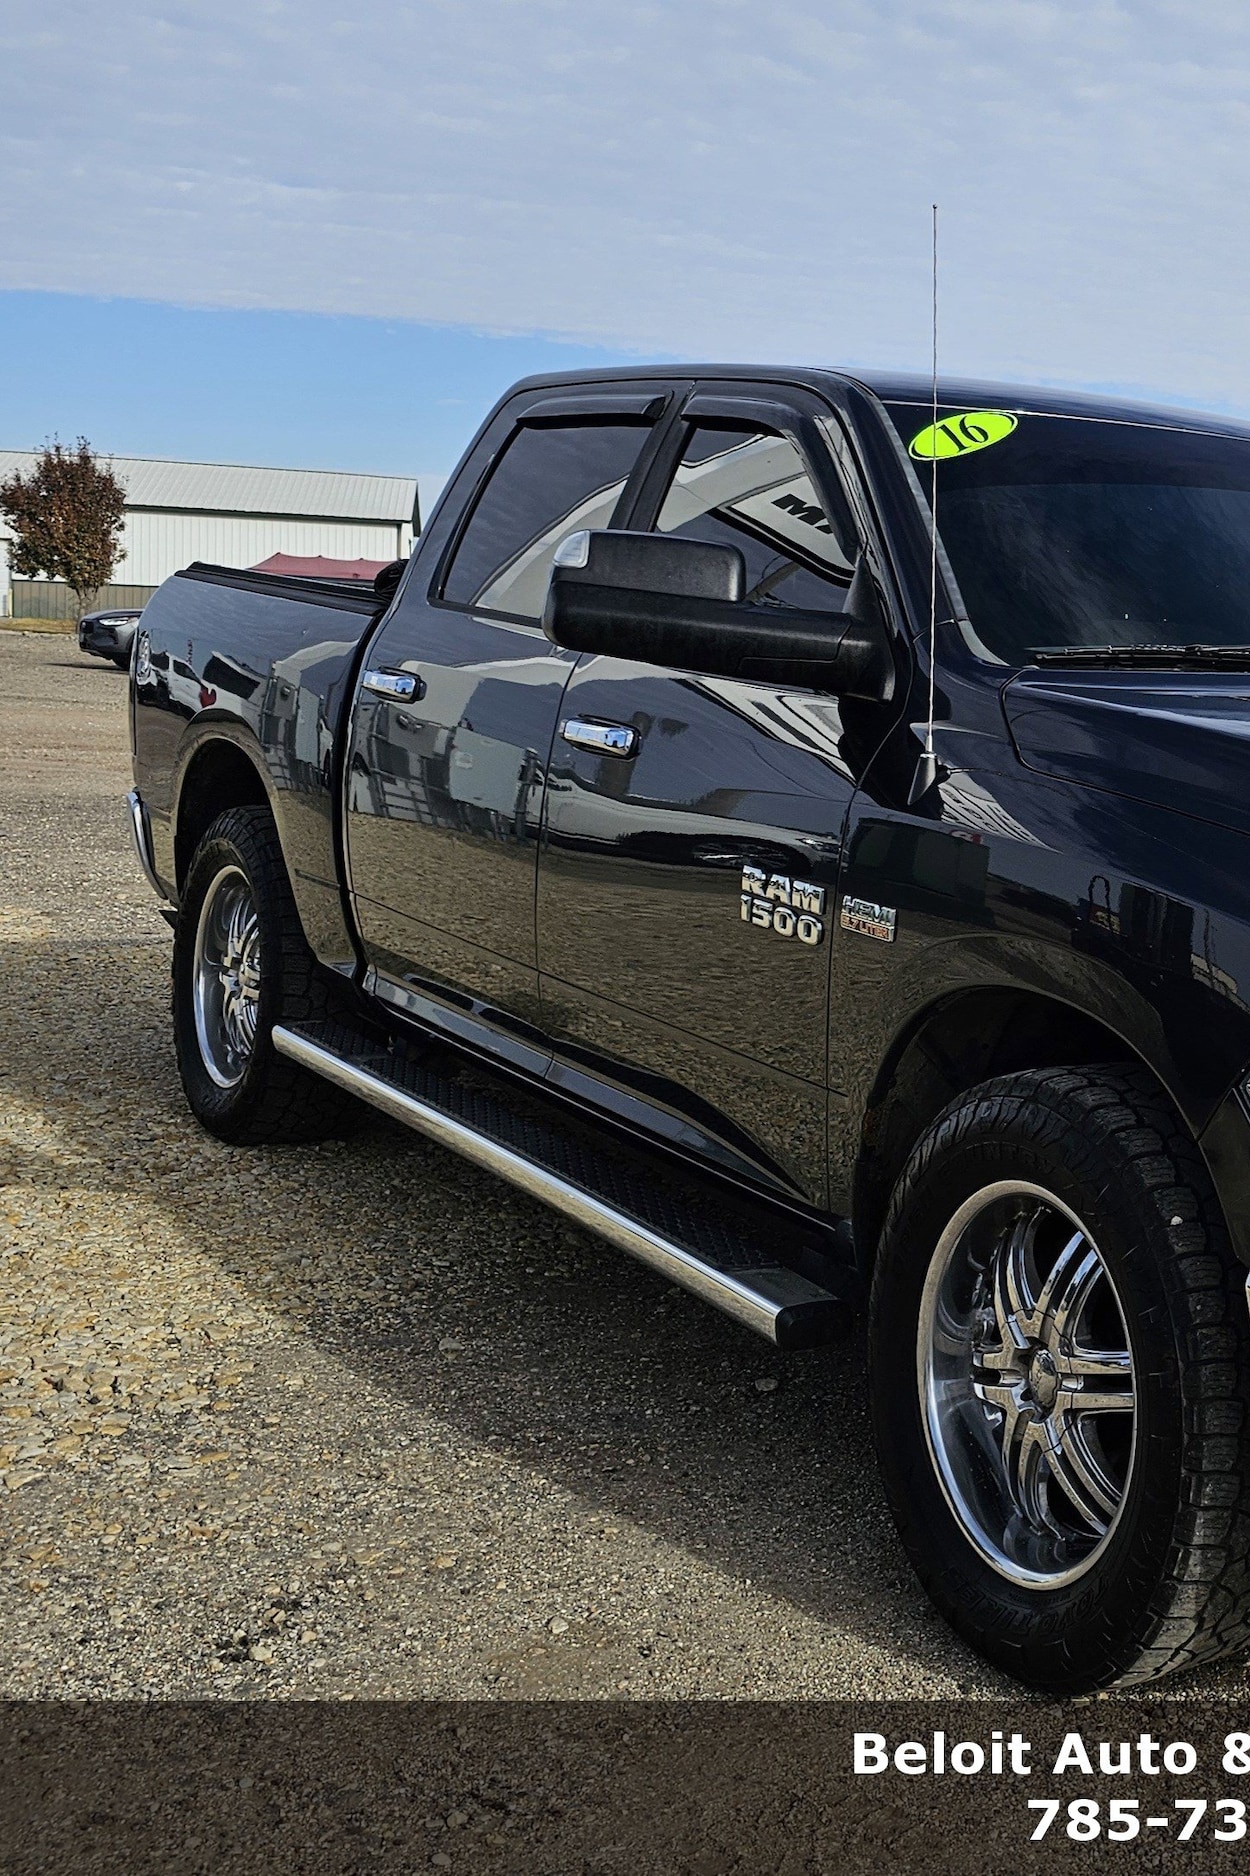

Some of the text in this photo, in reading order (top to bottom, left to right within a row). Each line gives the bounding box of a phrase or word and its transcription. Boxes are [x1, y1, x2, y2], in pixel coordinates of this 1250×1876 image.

[935, 414, 990, 453] 16
[741, 865, 825, 915] RAM
[741, 894, 824, 946] 1500
[842, 895, 897, 926] HEMI
[859, 920, 890, 939] LITER
